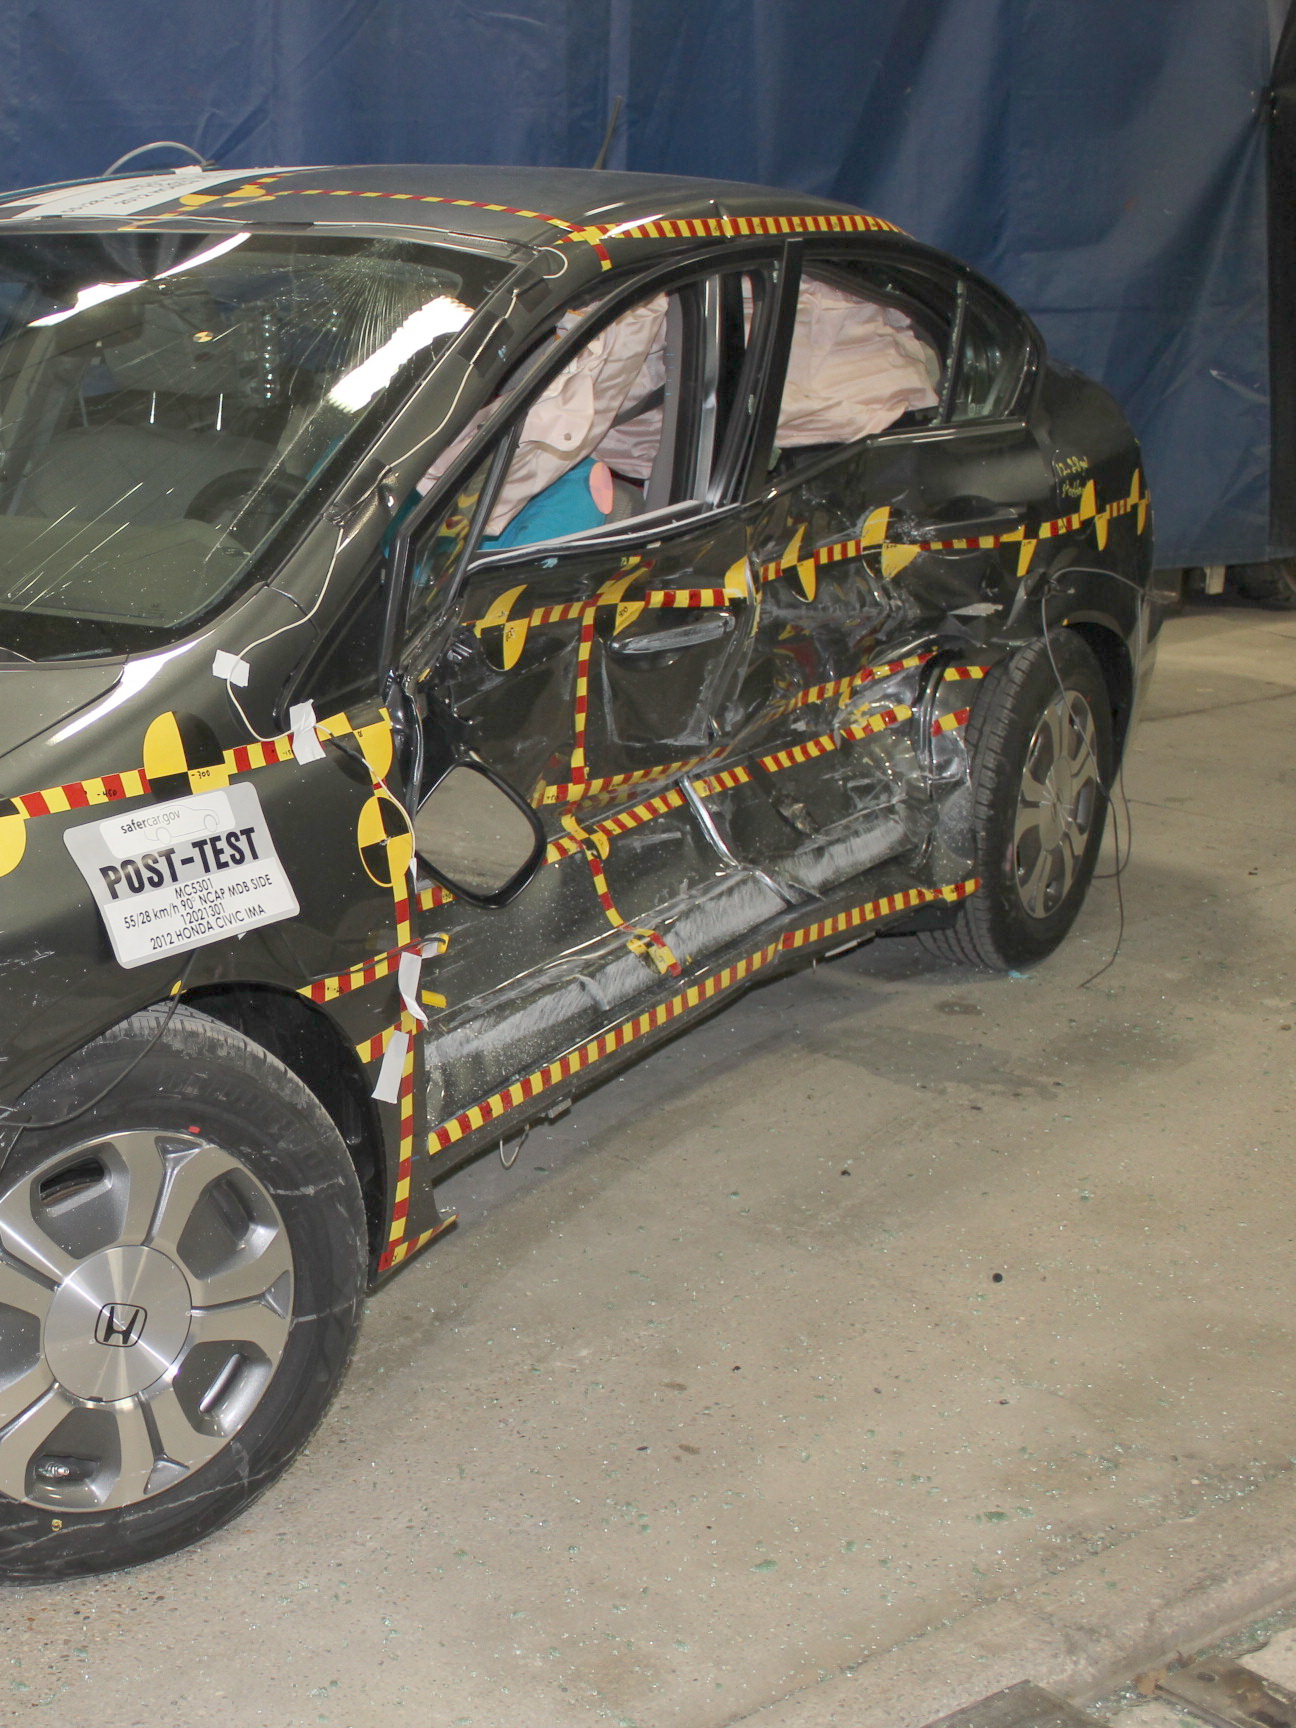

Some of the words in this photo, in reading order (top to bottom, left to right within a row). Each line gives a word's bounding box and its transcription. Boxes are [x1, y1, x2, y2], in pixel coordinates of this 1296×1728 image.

[120, 809, 181, 834] safercar.gov
[99, 827, 259, 900] POST-TEST
[124, 910, 152, 929] 55/28
[152, 901, 180, 921] km/h
[198, 888, 226, 906] NCAP
[228, 881, 251, 898] MDB
[251, 874, 273, 891] SIDE
[175, 878, 214, 899] MC5301
[149, 932, 175, 950] 2012
[176, 920, 215, 942] HONDA
[215, 909, 245, 930] CIVIC
[245, 903, 266, 921] IMA
[180, 902, 226, 926] 12021301
